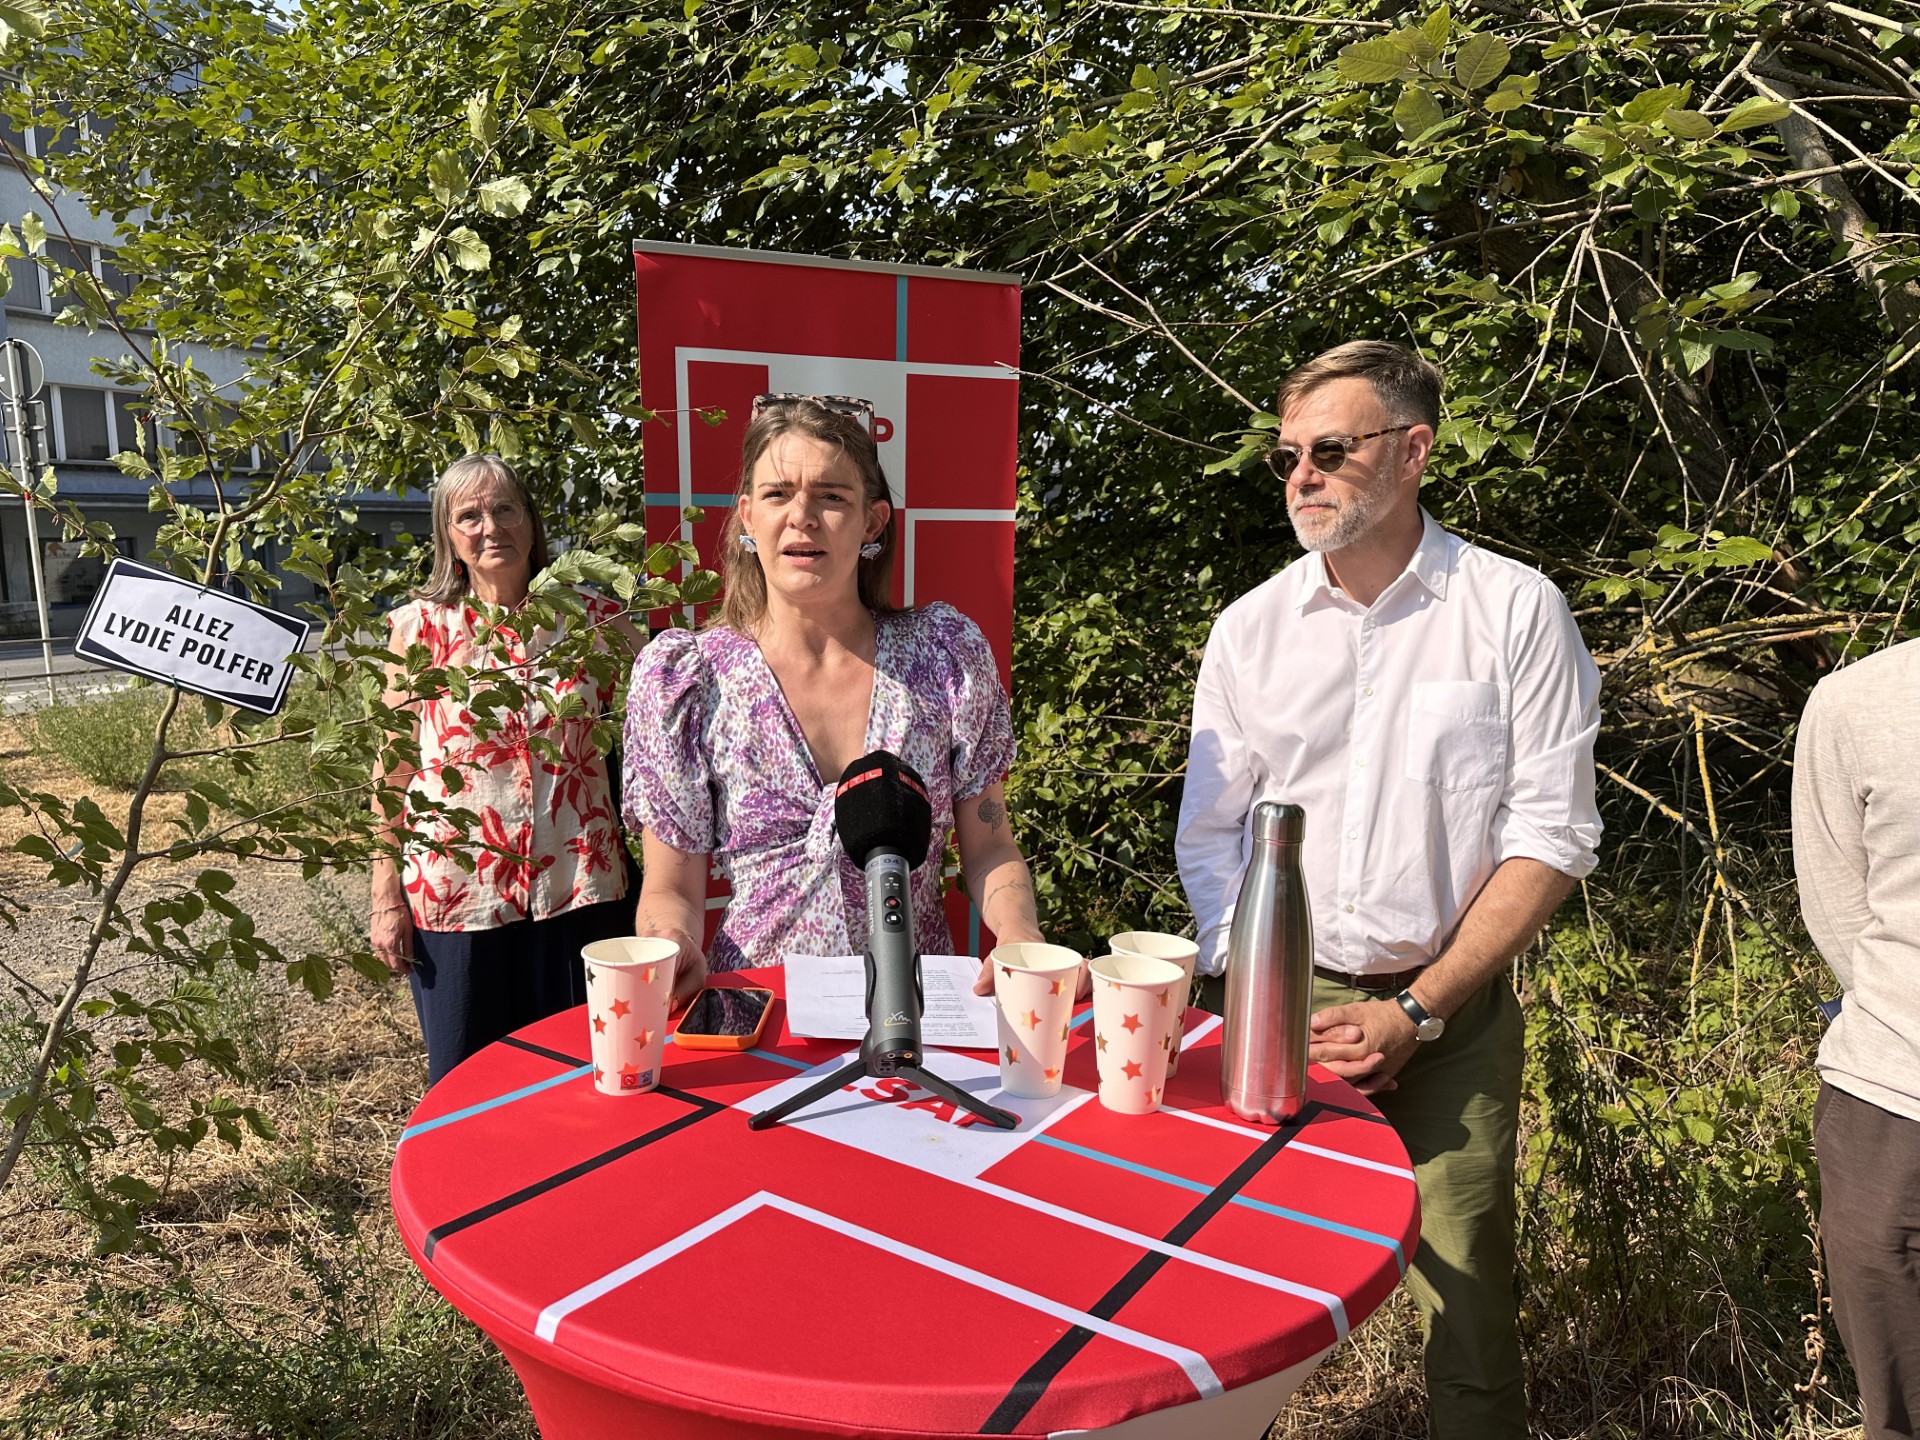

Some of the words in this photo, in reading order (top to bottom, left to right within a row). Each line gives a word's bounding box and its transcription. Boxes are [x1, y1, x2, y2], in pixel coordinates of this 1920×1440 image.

[103, 612, 176, 653] LYDIE
[178, 637, 274, 686] POLFER
[165, 604, 235, 642] ALLEZ
